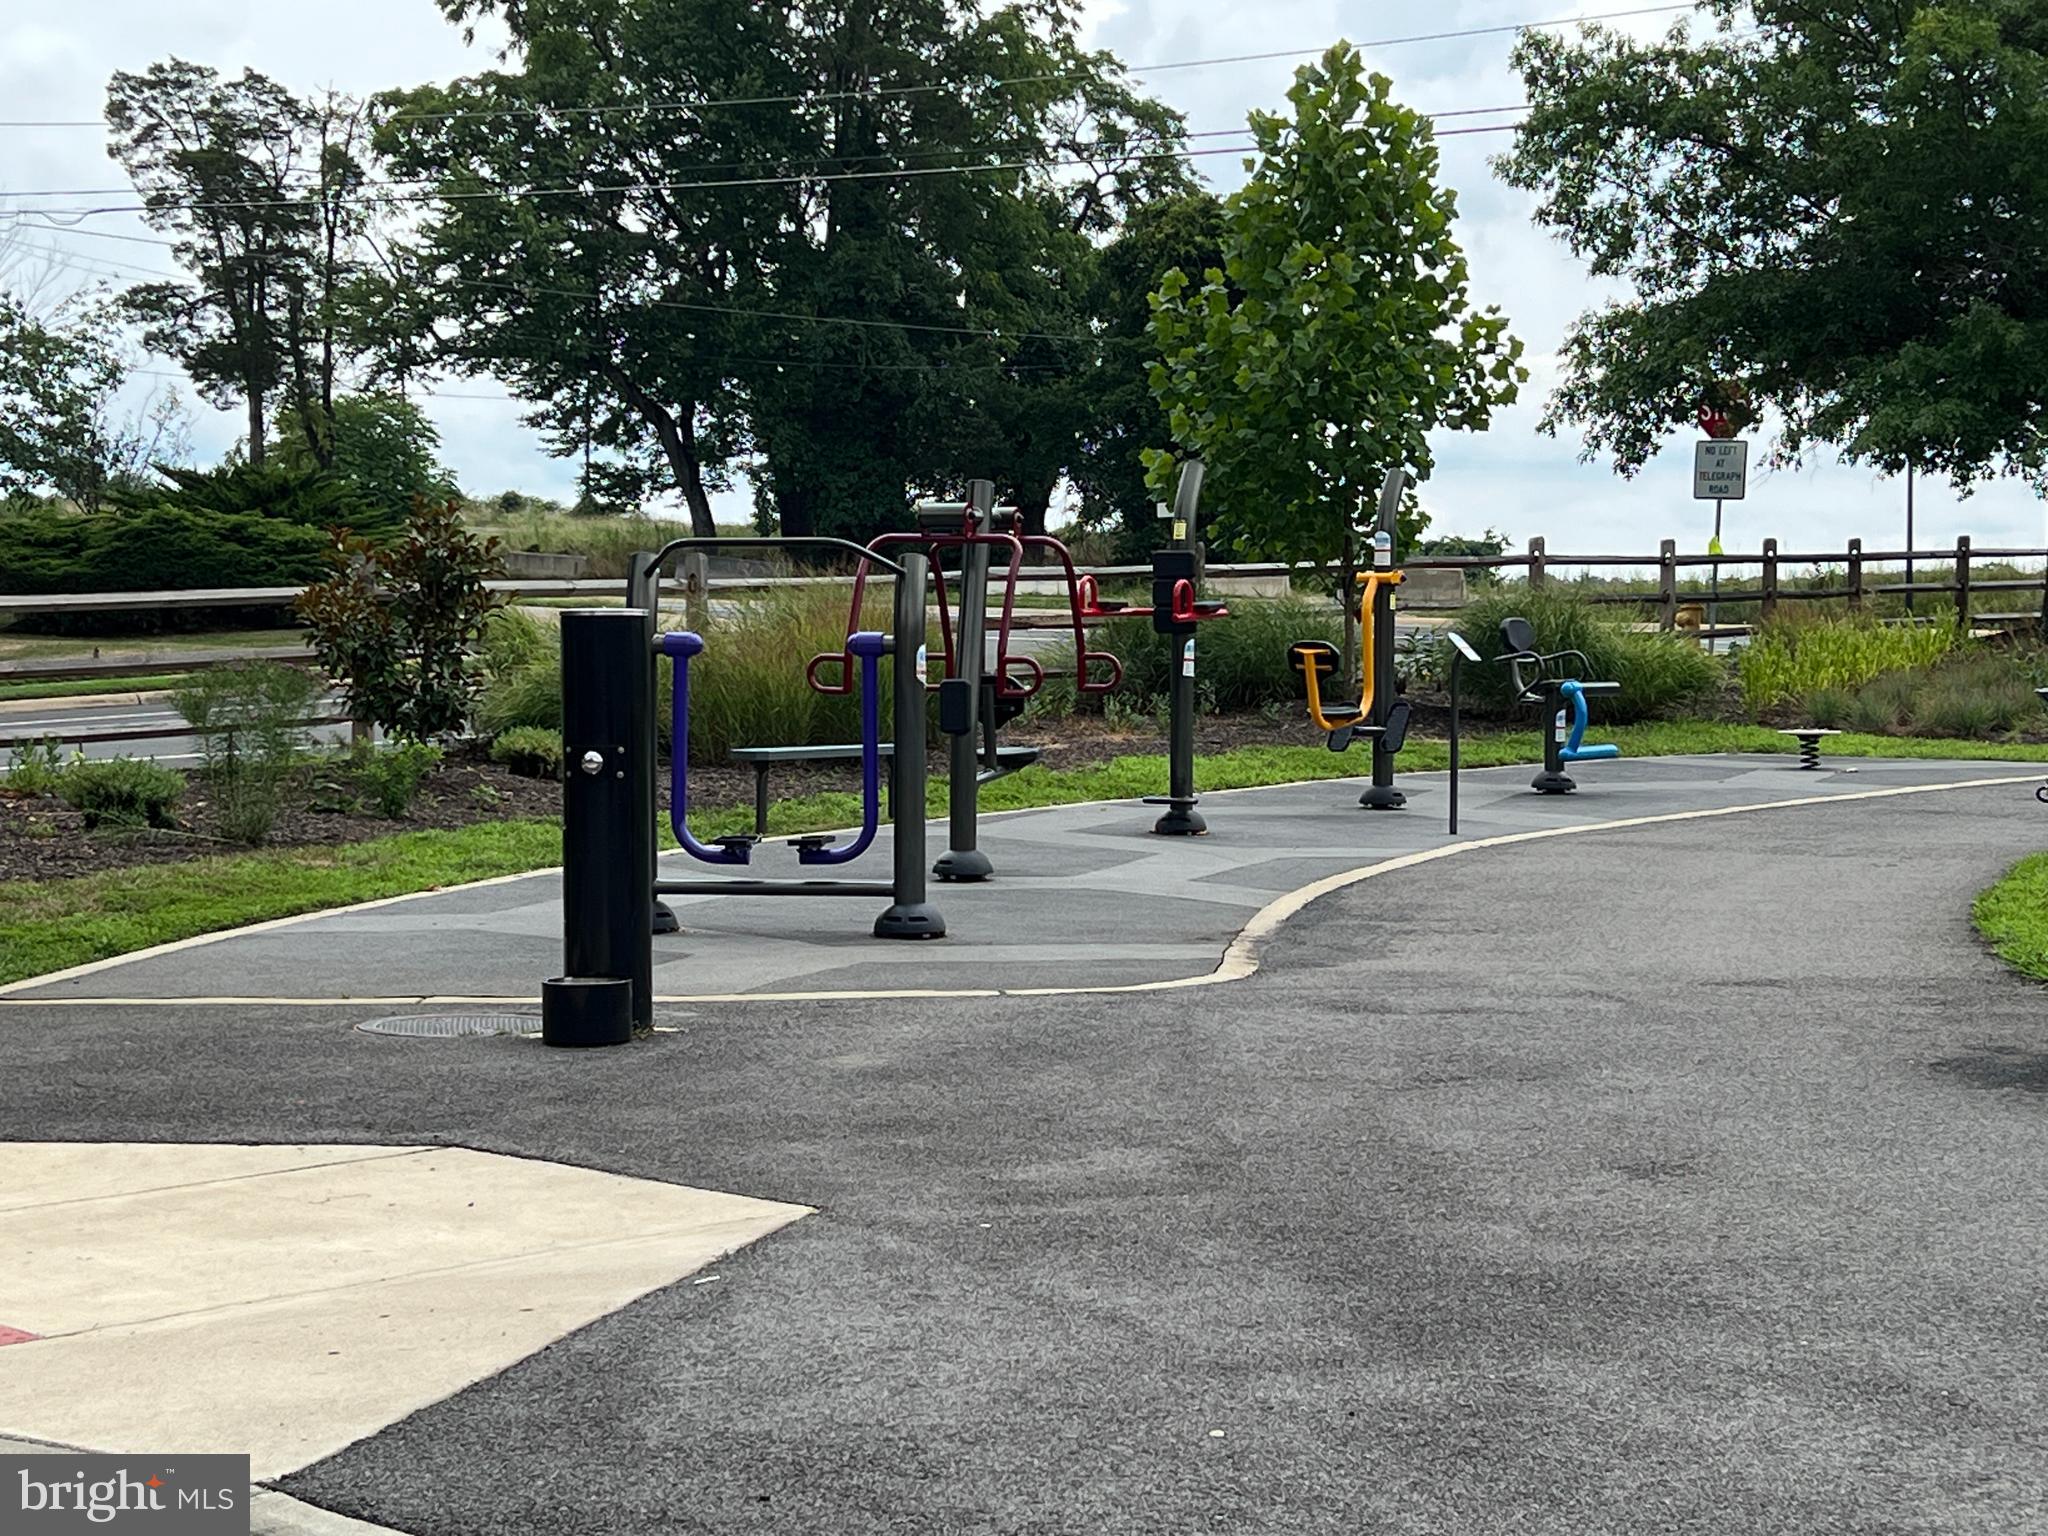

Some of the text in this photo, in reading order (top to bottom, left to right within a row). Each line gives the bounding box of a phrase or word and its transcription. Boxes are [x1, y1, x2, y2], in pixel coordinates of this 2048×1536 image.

[1705, 446, 1737, 455] NO LEFT
[1716, 459, 1725, 468] AT
[1700, 471, 1741, 481] TELEGRAPH
[1709, 484, 1729, 494] ROAD
